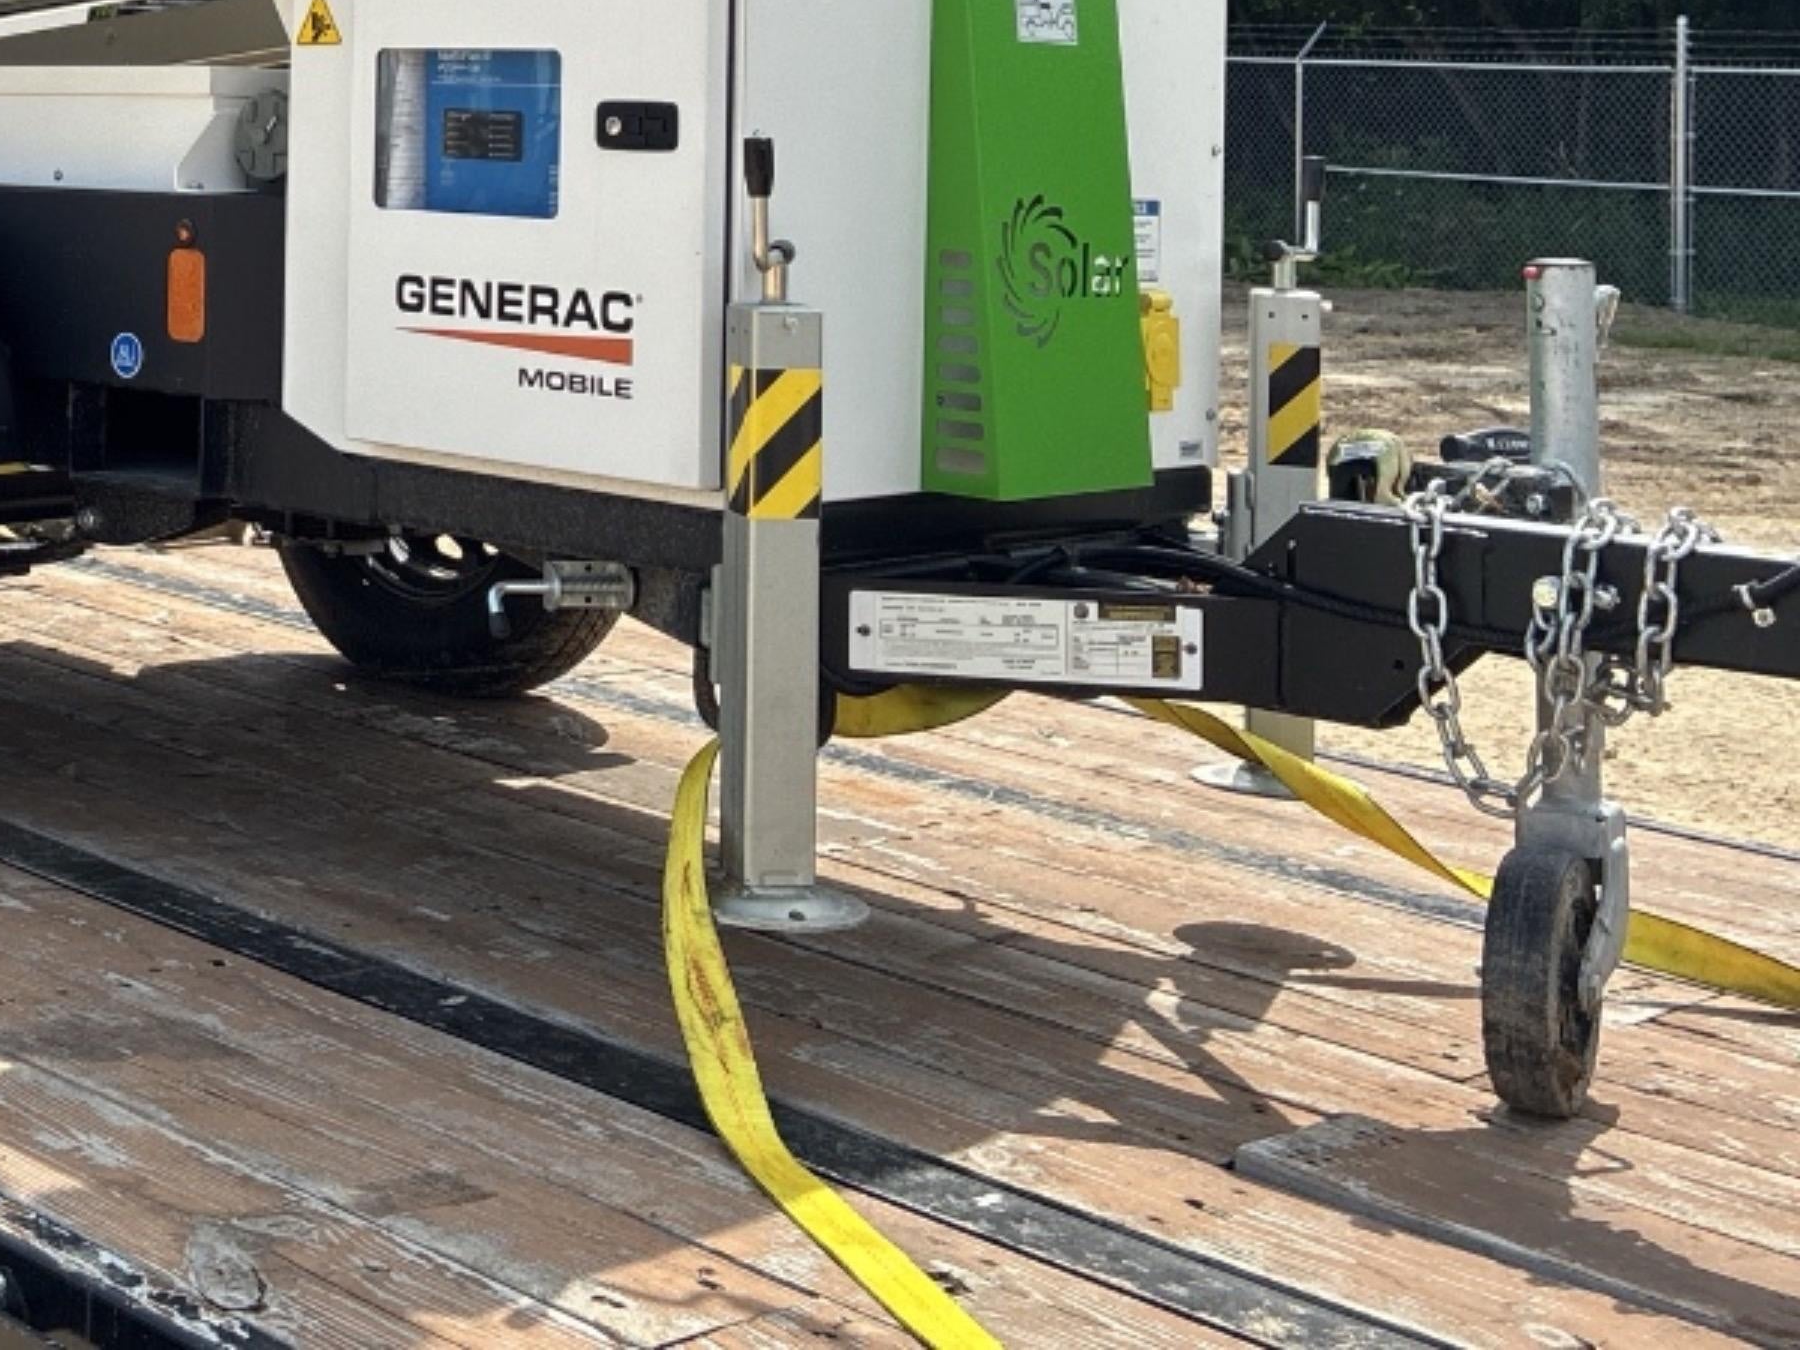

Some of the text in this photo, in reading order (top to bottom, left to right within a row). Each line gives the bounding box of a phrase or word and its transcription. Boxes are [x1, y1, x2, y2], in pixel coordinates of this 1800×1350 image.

[1029, 241, 1130, 299] Solar
[395, 273, 634, 333] GENERAC
[517, 367, 634, 400] MOBILE
